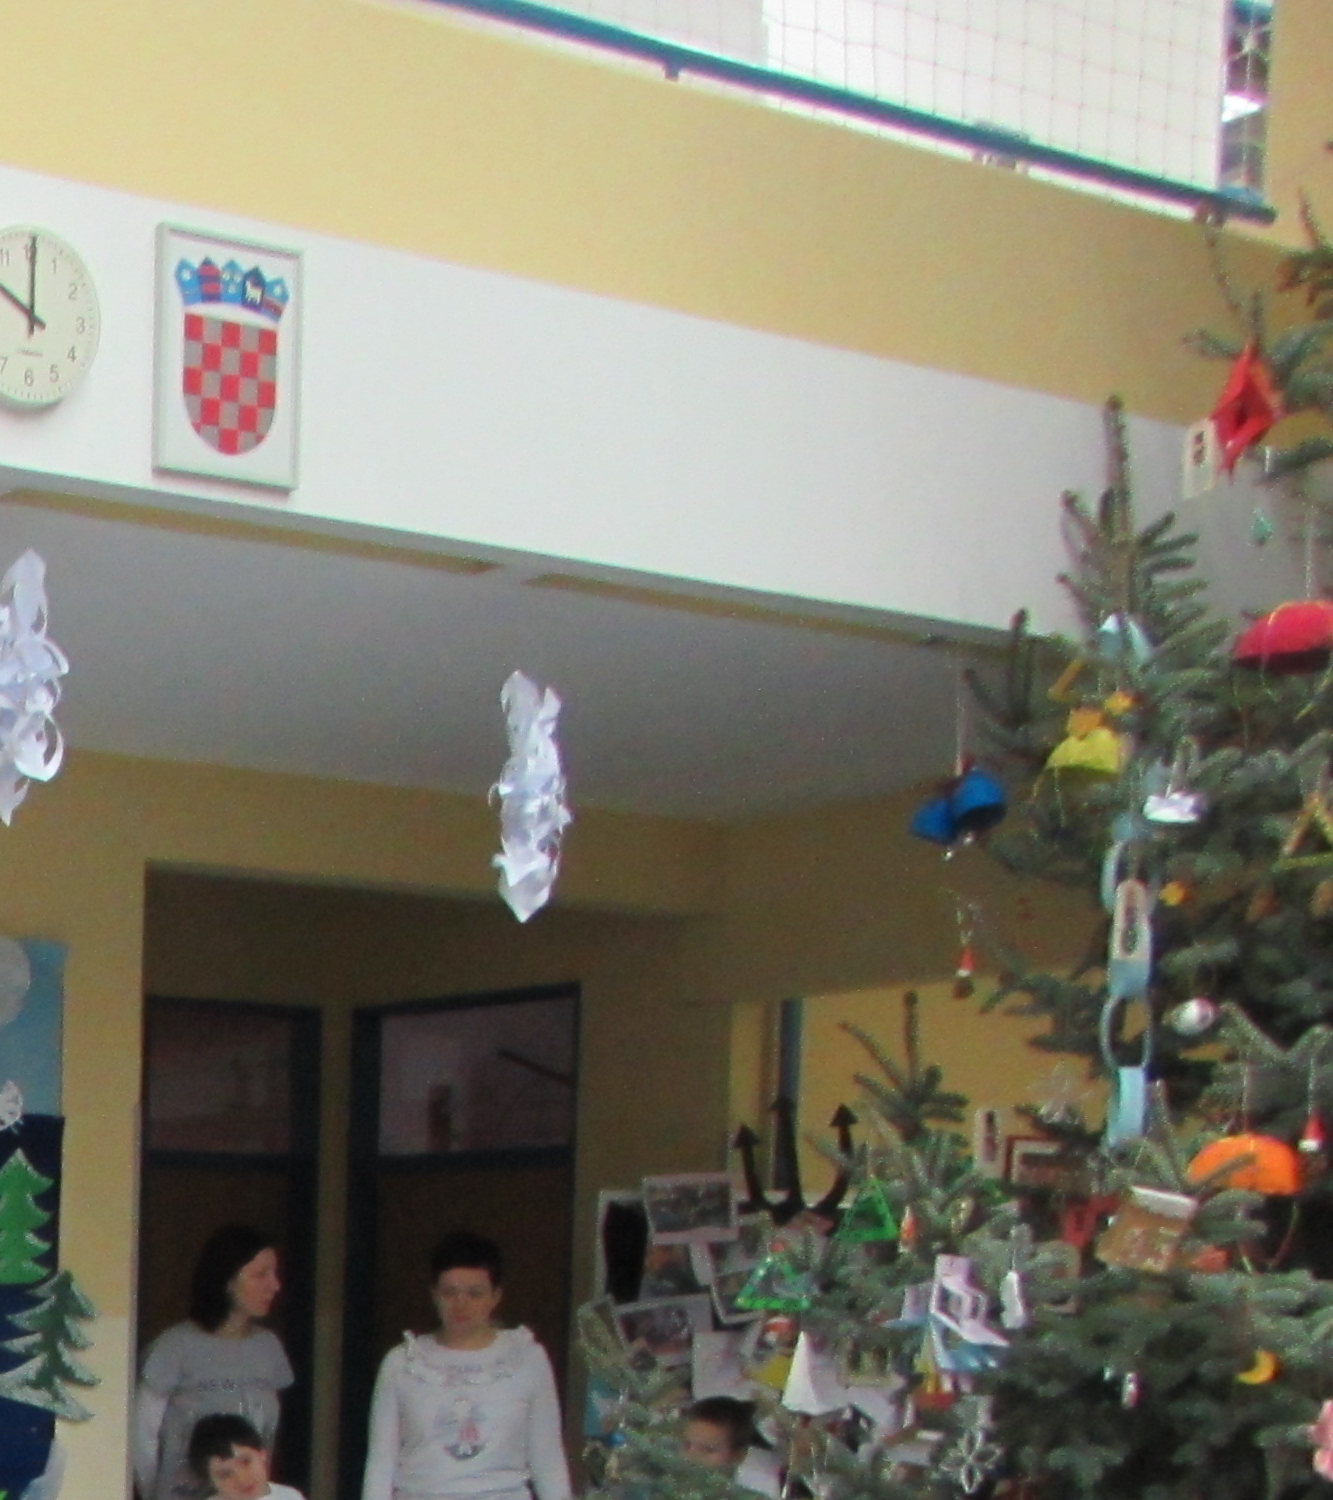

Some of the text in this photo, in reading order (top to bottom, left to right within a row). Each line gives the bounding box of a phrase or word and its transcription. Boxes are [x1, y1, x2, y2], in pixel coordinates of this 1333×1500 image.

[0, 248, 10, 266] 11
[52, 257, 58, 274] 1
[68, 283, 78, 301] 2
[76, 317, 85, 334] 3
[67, 346, 77, 363] 4
[24, 368, 34, 387] 6
[50, 364, 60, 383] 5
